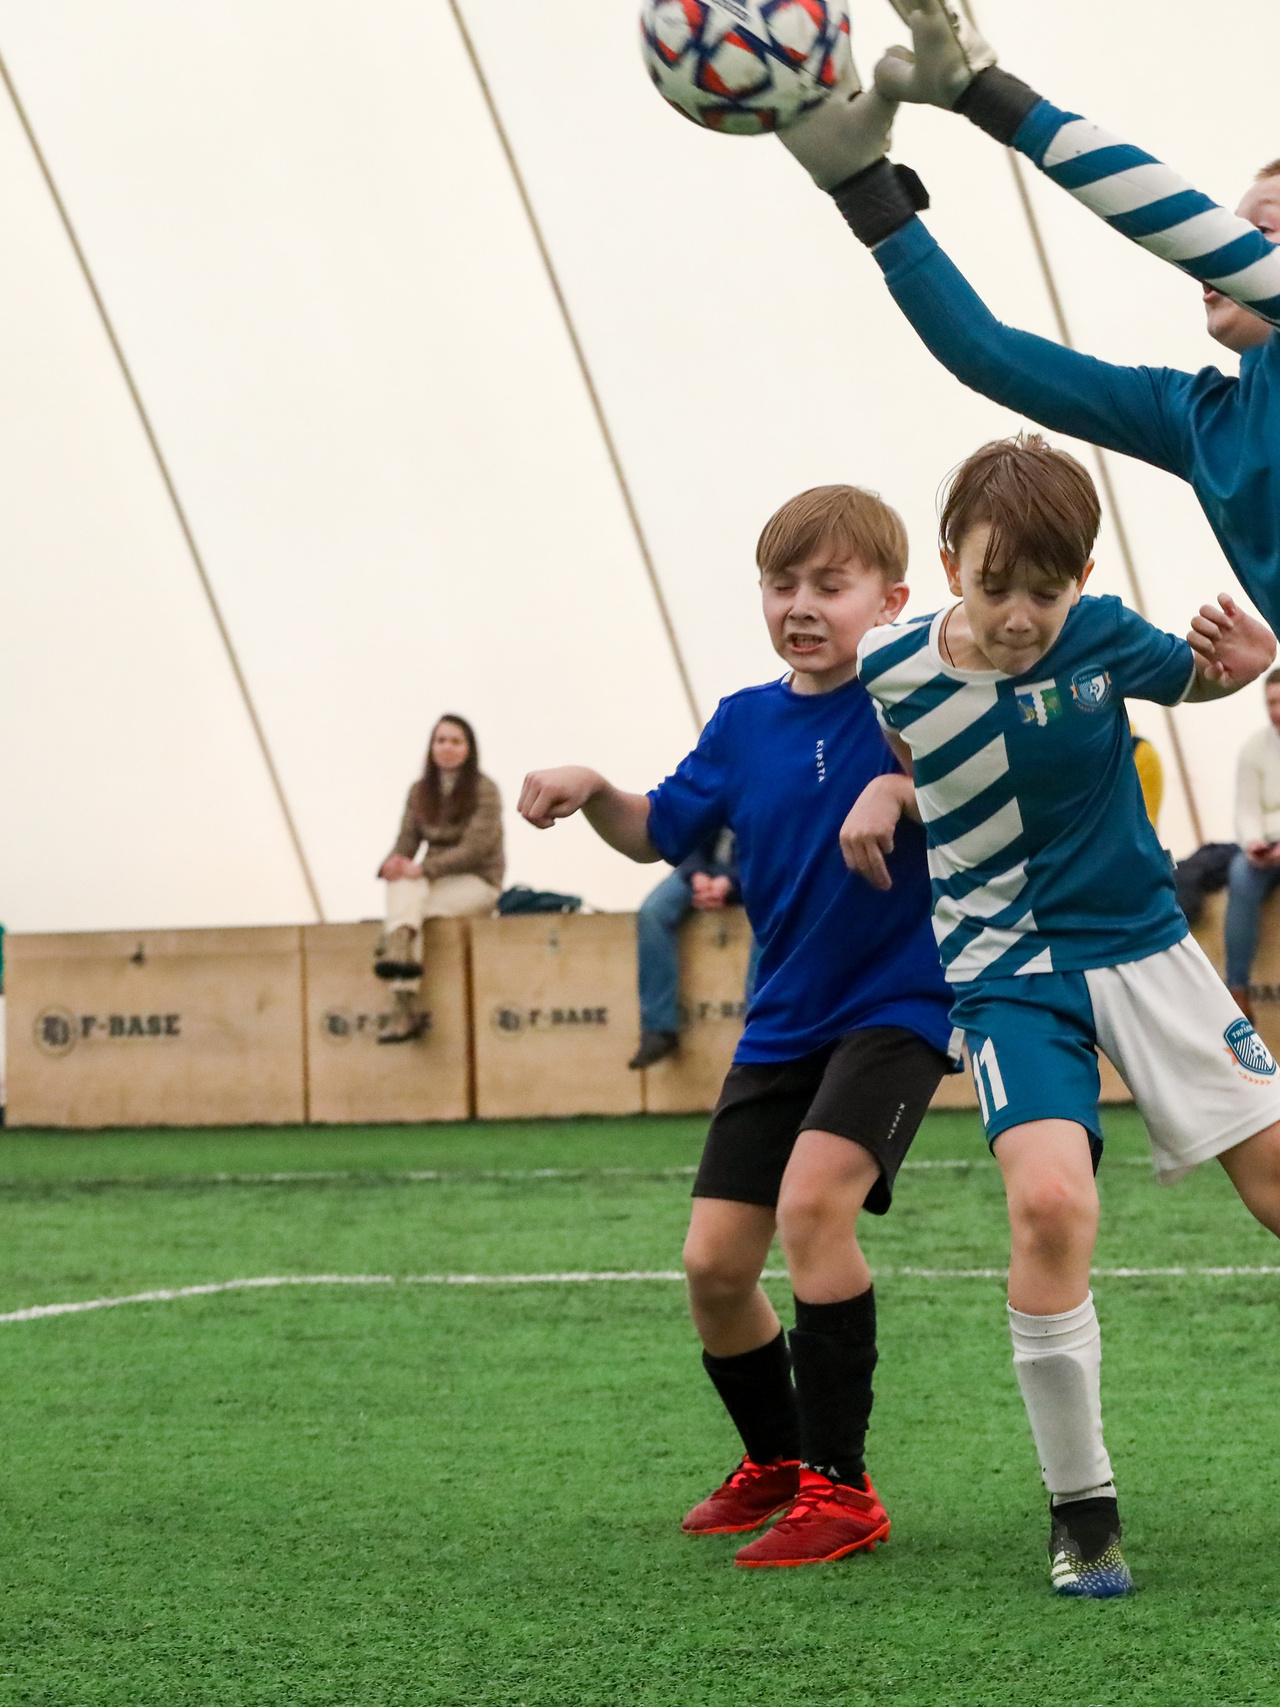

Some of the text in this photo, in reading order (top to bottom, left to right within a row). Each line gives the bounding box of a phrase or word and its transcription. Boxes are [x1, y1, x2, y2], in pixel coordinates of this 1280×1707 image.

[815, 739, 826, 783] KIPSTA
[81, 1014, 181, 1038] F-BASE
[973, 1036, 1008, 1128] 11
